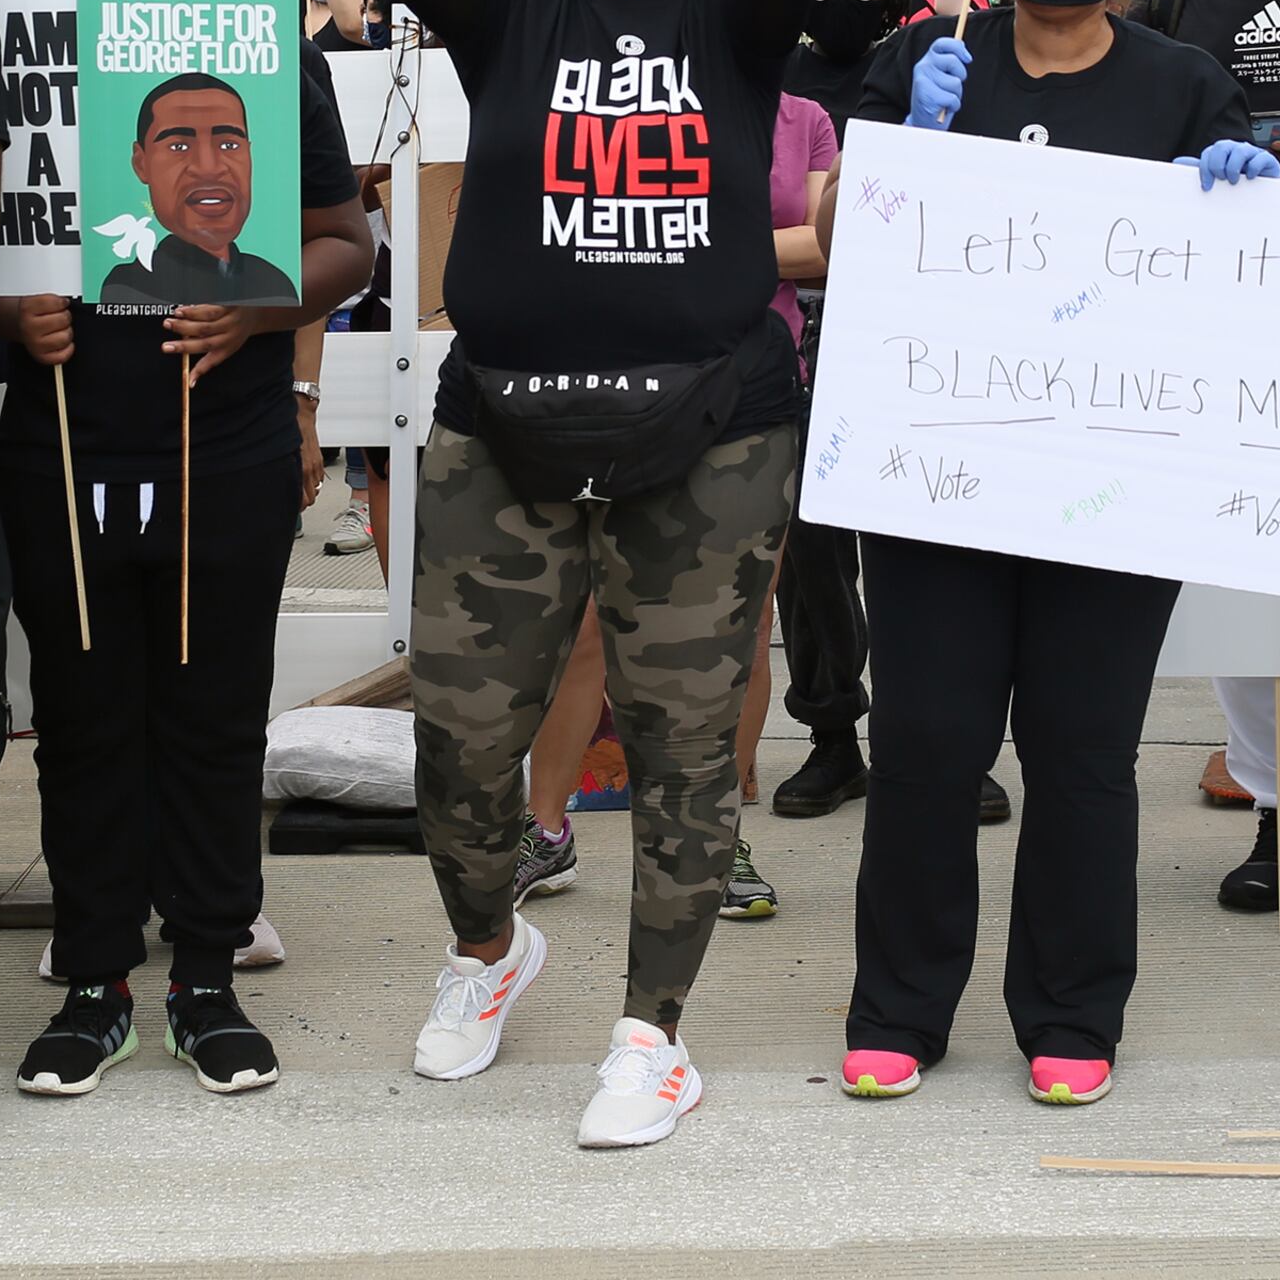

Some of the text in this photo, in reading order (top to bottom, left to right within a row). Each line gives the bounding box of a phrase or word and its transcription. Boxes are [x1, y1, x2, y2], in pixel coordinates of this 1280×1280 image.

[97, 2, 277, 42] JUSTICE FOR
[97, 40, 279, 75] GEORGE FLOYD
[27, 132, 61, 187] A
[543, 113, 710, 196] LIVES
[917, 199, 1203, 286] Let's Get
[884, 336, 1076, 409] BLACK
[1087, 362, 1212, 417] LIVES
